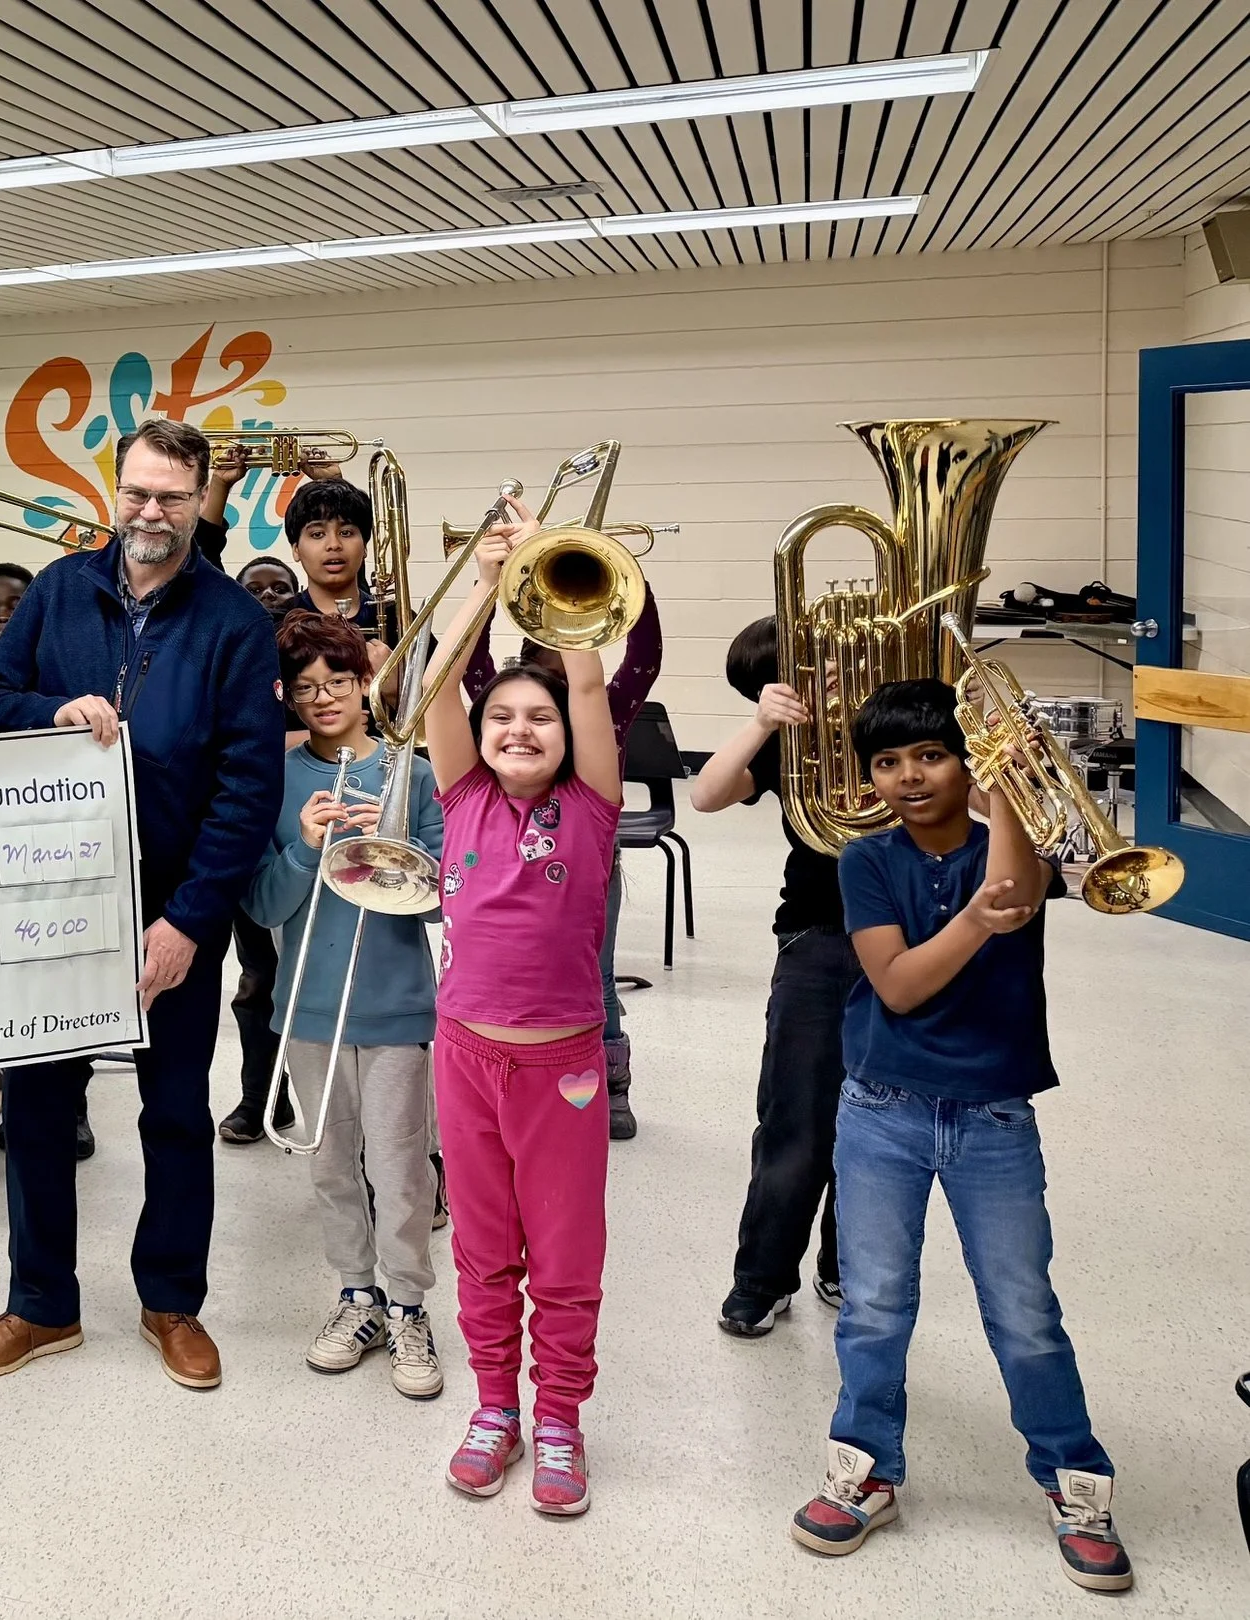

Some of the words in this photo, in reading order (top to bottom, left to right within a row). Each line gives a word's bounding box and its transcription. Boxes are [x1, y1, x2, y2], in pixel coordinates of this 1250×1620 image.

[2, 843, 73, 874] March
[79, 841, 102, 859] 27
[14, 917, 88, 946] 40,000
[20, 1016, 37, 1040] of
[42, 1010, 121, 1034] Directors
